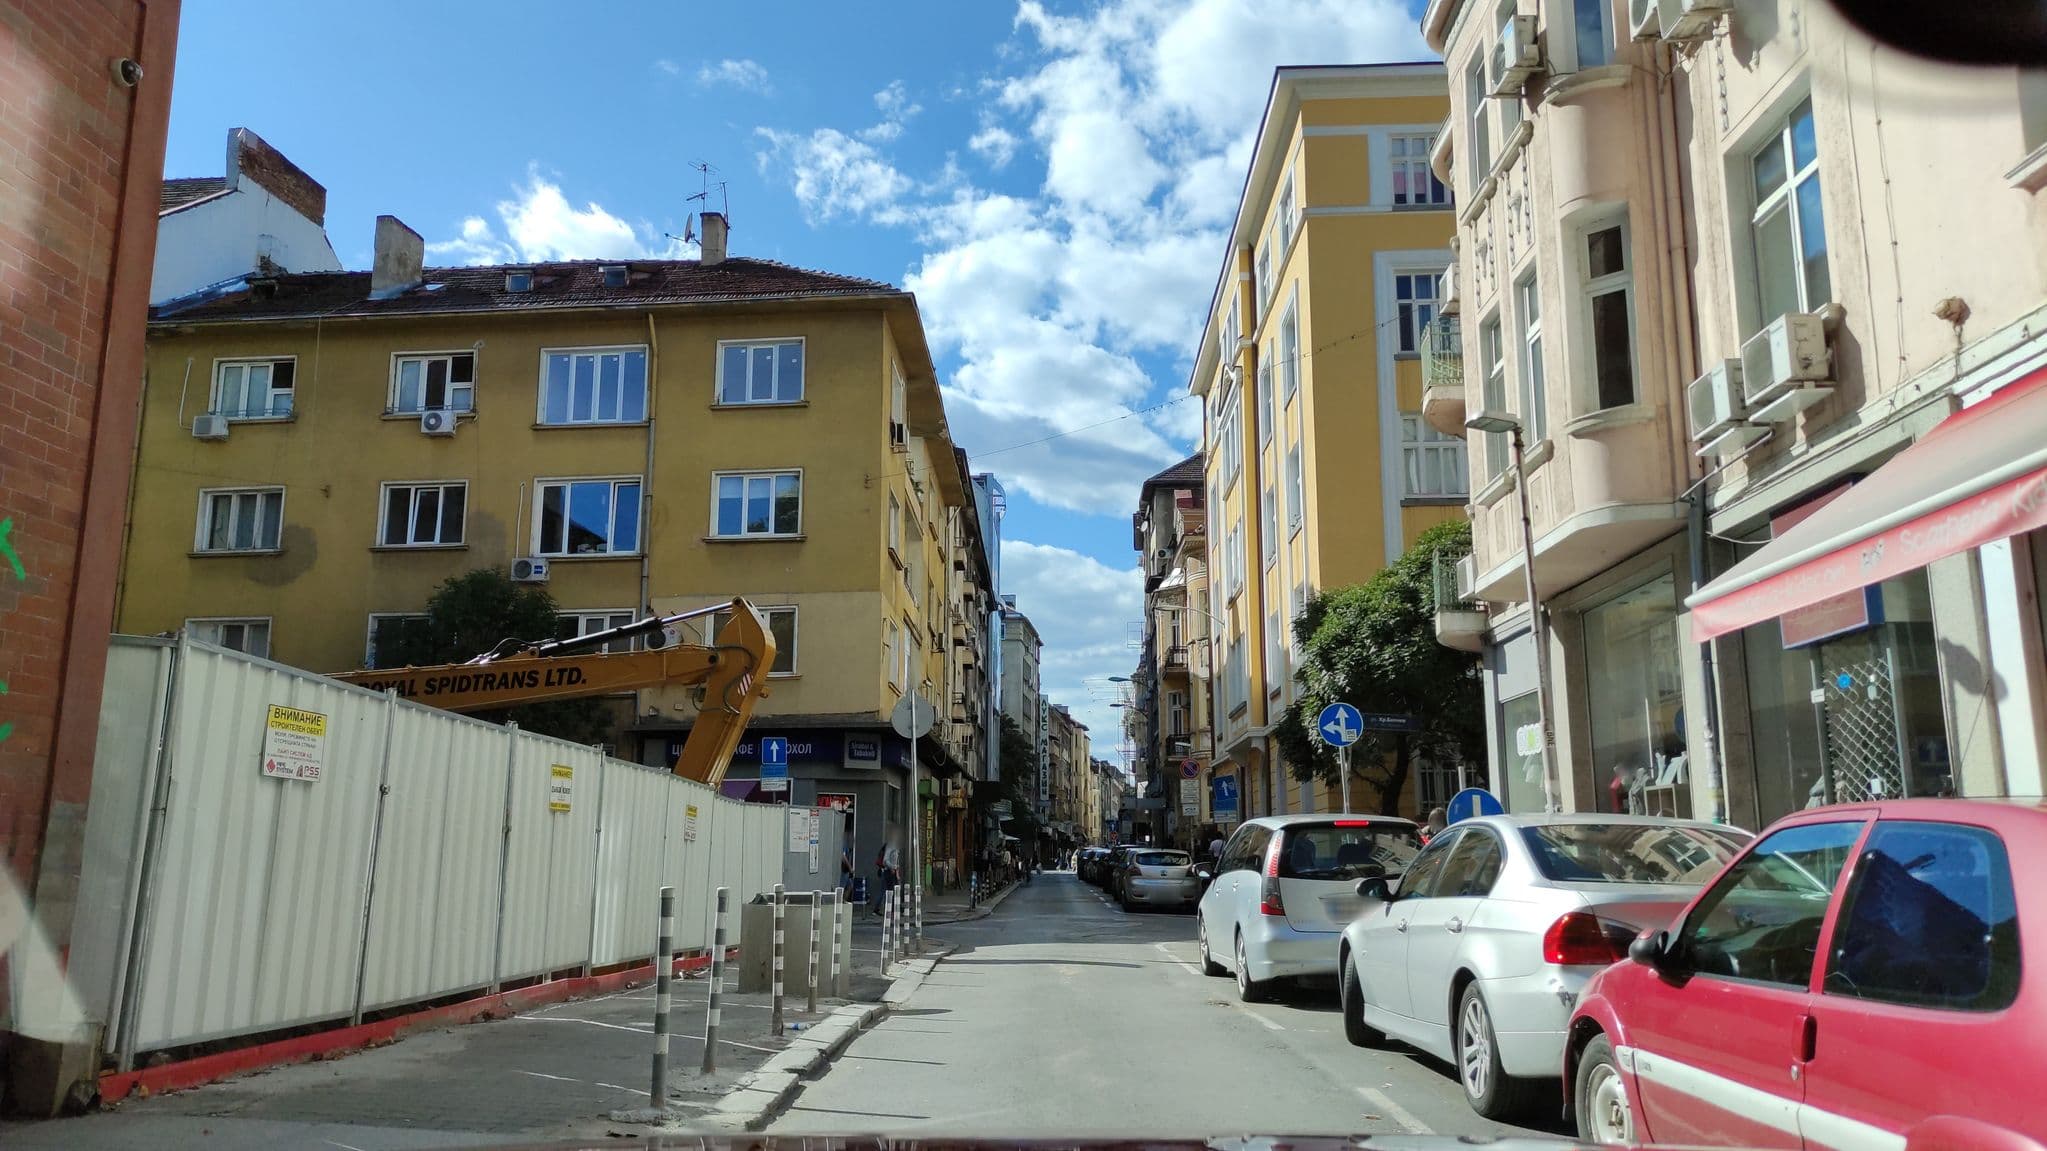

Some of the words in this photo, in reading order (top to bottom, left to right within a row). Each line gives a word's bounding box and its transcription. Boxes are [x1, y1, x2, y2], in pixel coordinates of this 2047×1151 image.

[424, 671, 539, 695] SPIDTRANS
[544, 667, 587, 687] LTD.
[274, 708, 322, 727] ВНИМАНИЕ
